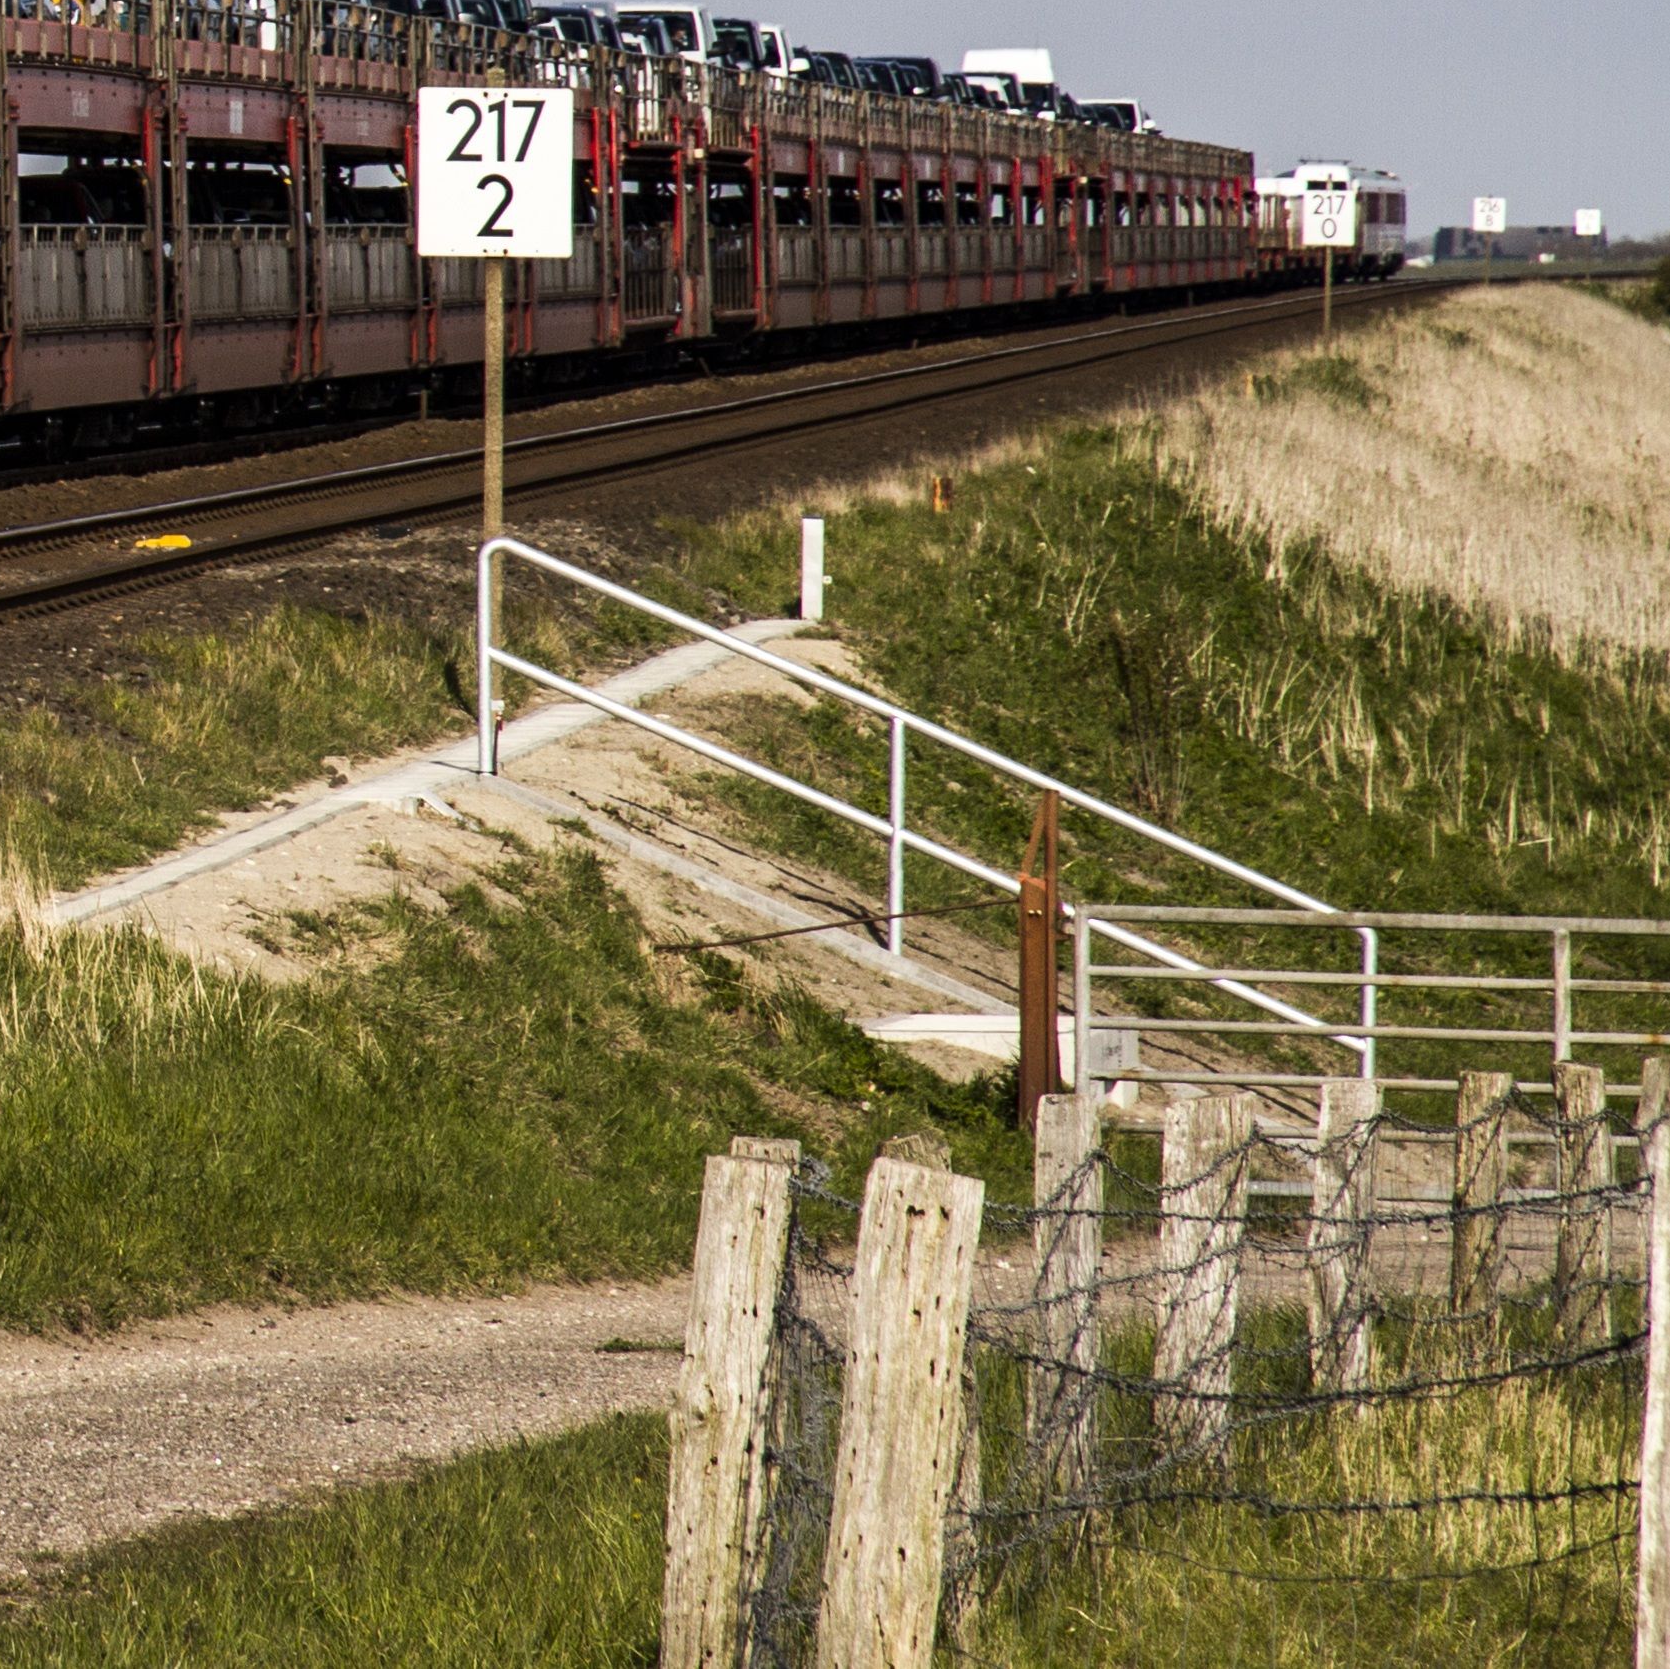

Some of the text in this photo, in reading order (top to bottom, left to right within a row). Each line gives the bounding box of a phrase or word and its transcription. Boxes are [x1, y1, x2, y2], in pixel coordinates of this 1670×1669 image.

[445, 98, 546, 162] 217
[476, 173, 514, 237] 2
[1313, 194, 1346, 215] 217
[1321, 217, 1337, 239] 0
